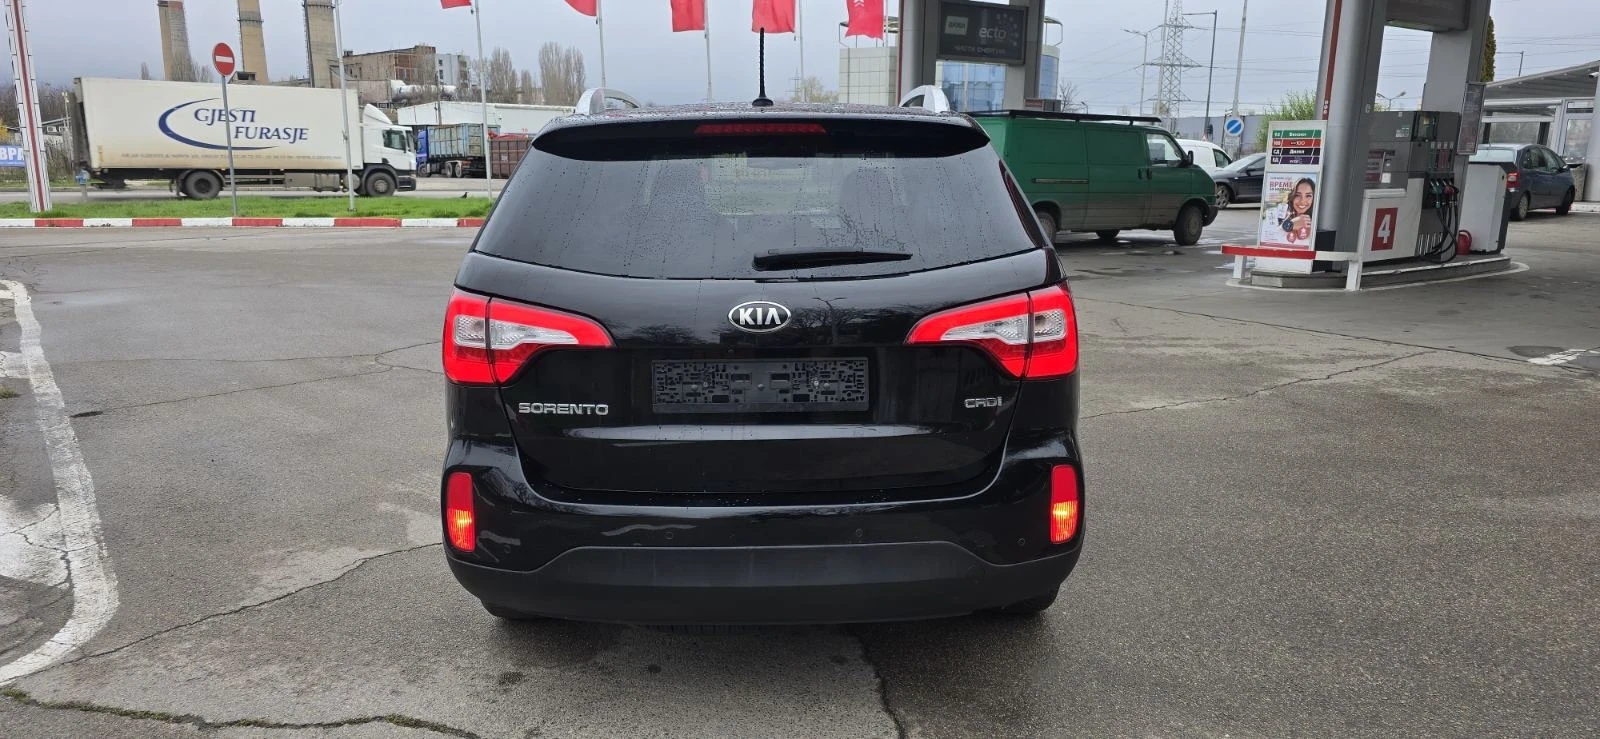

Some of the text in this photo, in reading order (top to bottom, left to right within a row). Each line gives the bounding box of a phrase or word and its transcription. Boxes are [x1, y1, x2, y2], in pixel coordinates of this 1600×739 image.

[979, 27, 1007, 39] ecto
[194, 108, 256, 126] GJESTI
[234, 126, 309, 144] FURASJE
[1377, 214, 1391, 244] 4
[739, 307, 782, 325] KIA
[518, 402, 609, 416] SORENTO
